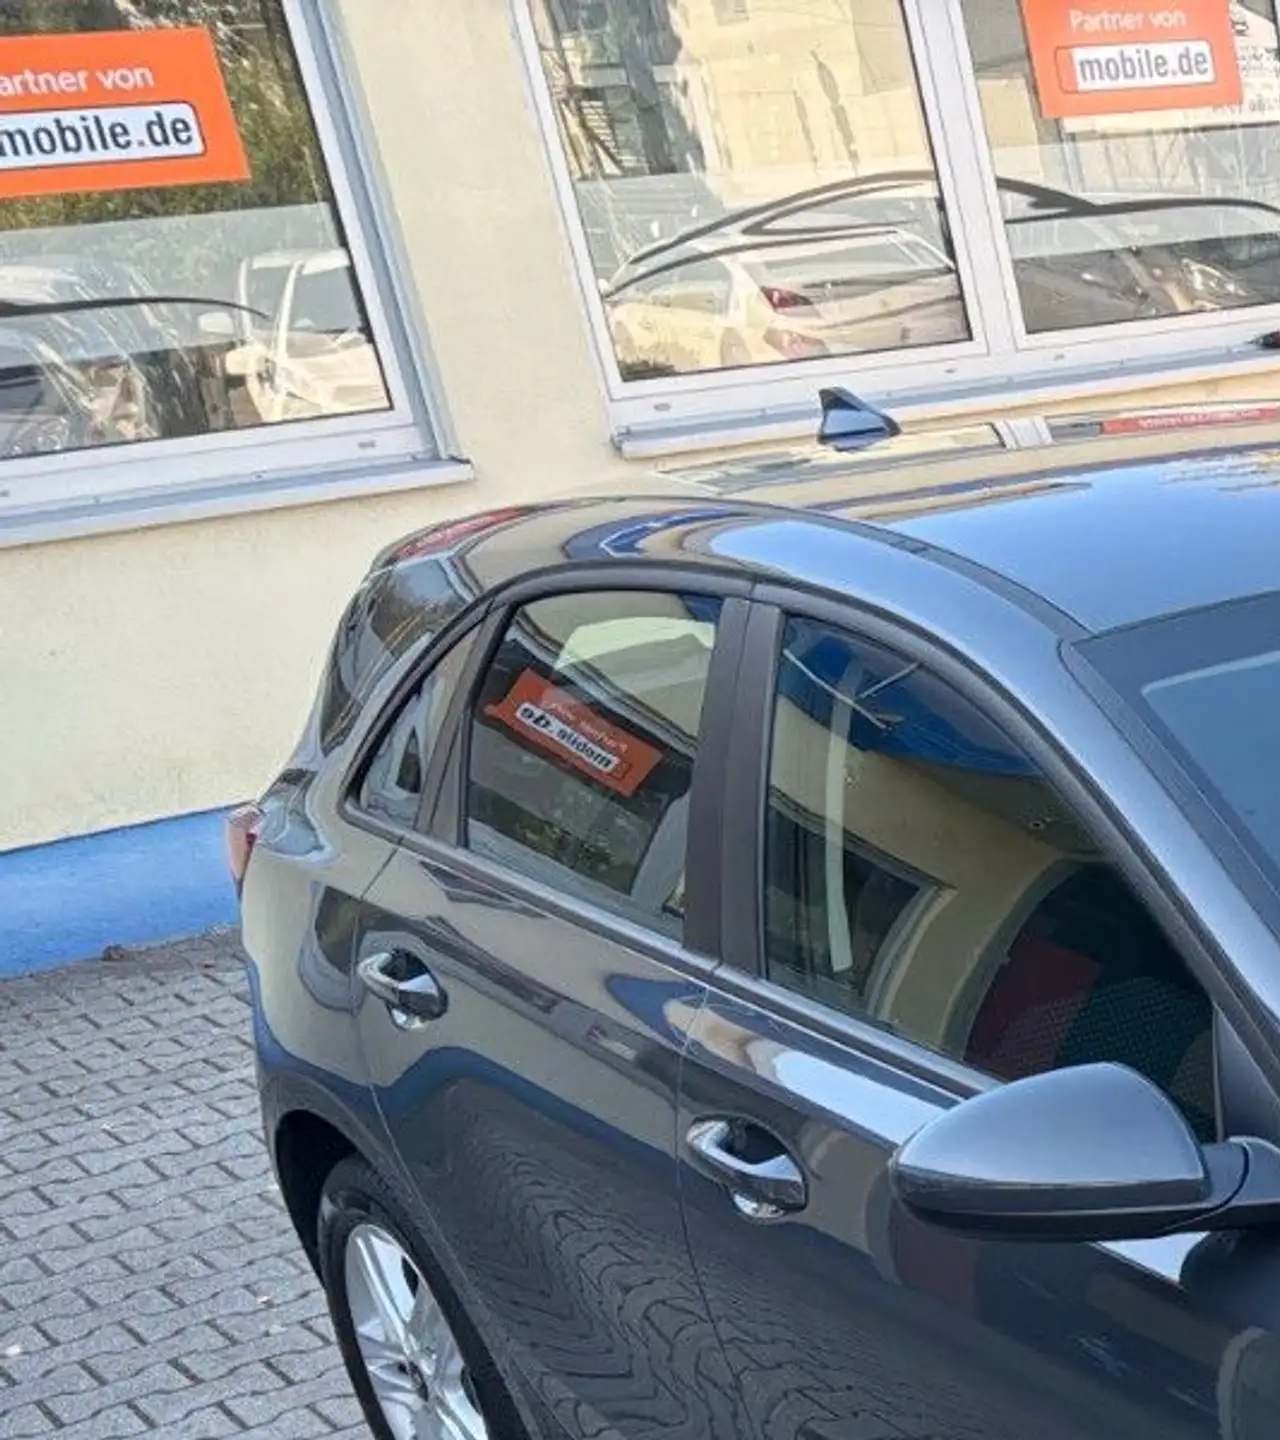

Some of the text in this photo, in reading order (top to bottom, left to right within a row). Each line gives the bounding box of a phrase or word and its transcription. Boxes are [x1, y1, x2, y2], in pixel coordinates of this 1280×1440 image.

[1069, 9, 1186, 33] Partner von
[1079, 46, 1209, 83] mobile.de
[0, 67, 155, 96] artner von
[0, 109, 194, 158] mobile.de
